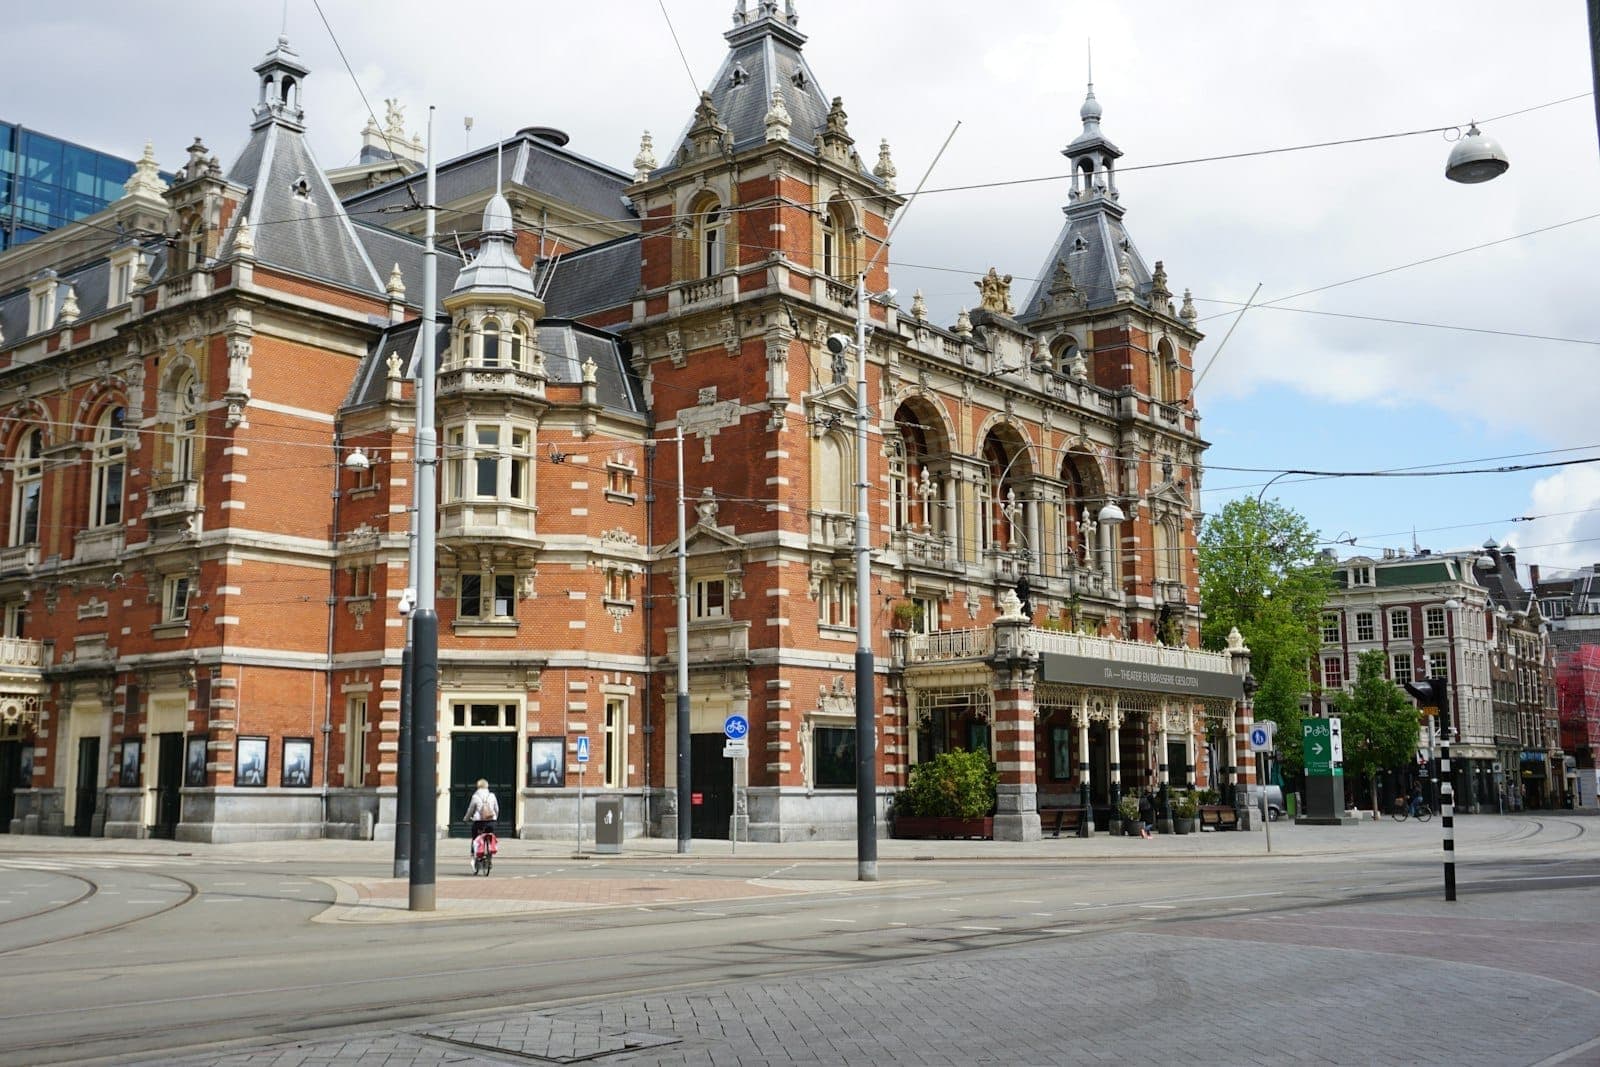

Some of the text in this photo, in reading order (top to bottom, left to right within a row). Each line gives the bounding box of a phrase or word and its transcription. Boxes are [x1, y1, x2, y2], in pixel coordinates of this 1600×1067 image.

[1120, 669, 1142, 681] THEATER
[1142, 671, 1150, 682] EN
[1150, 672, 1175, 685] BRASSERIE
[1304, 725, 1313, 737] P
